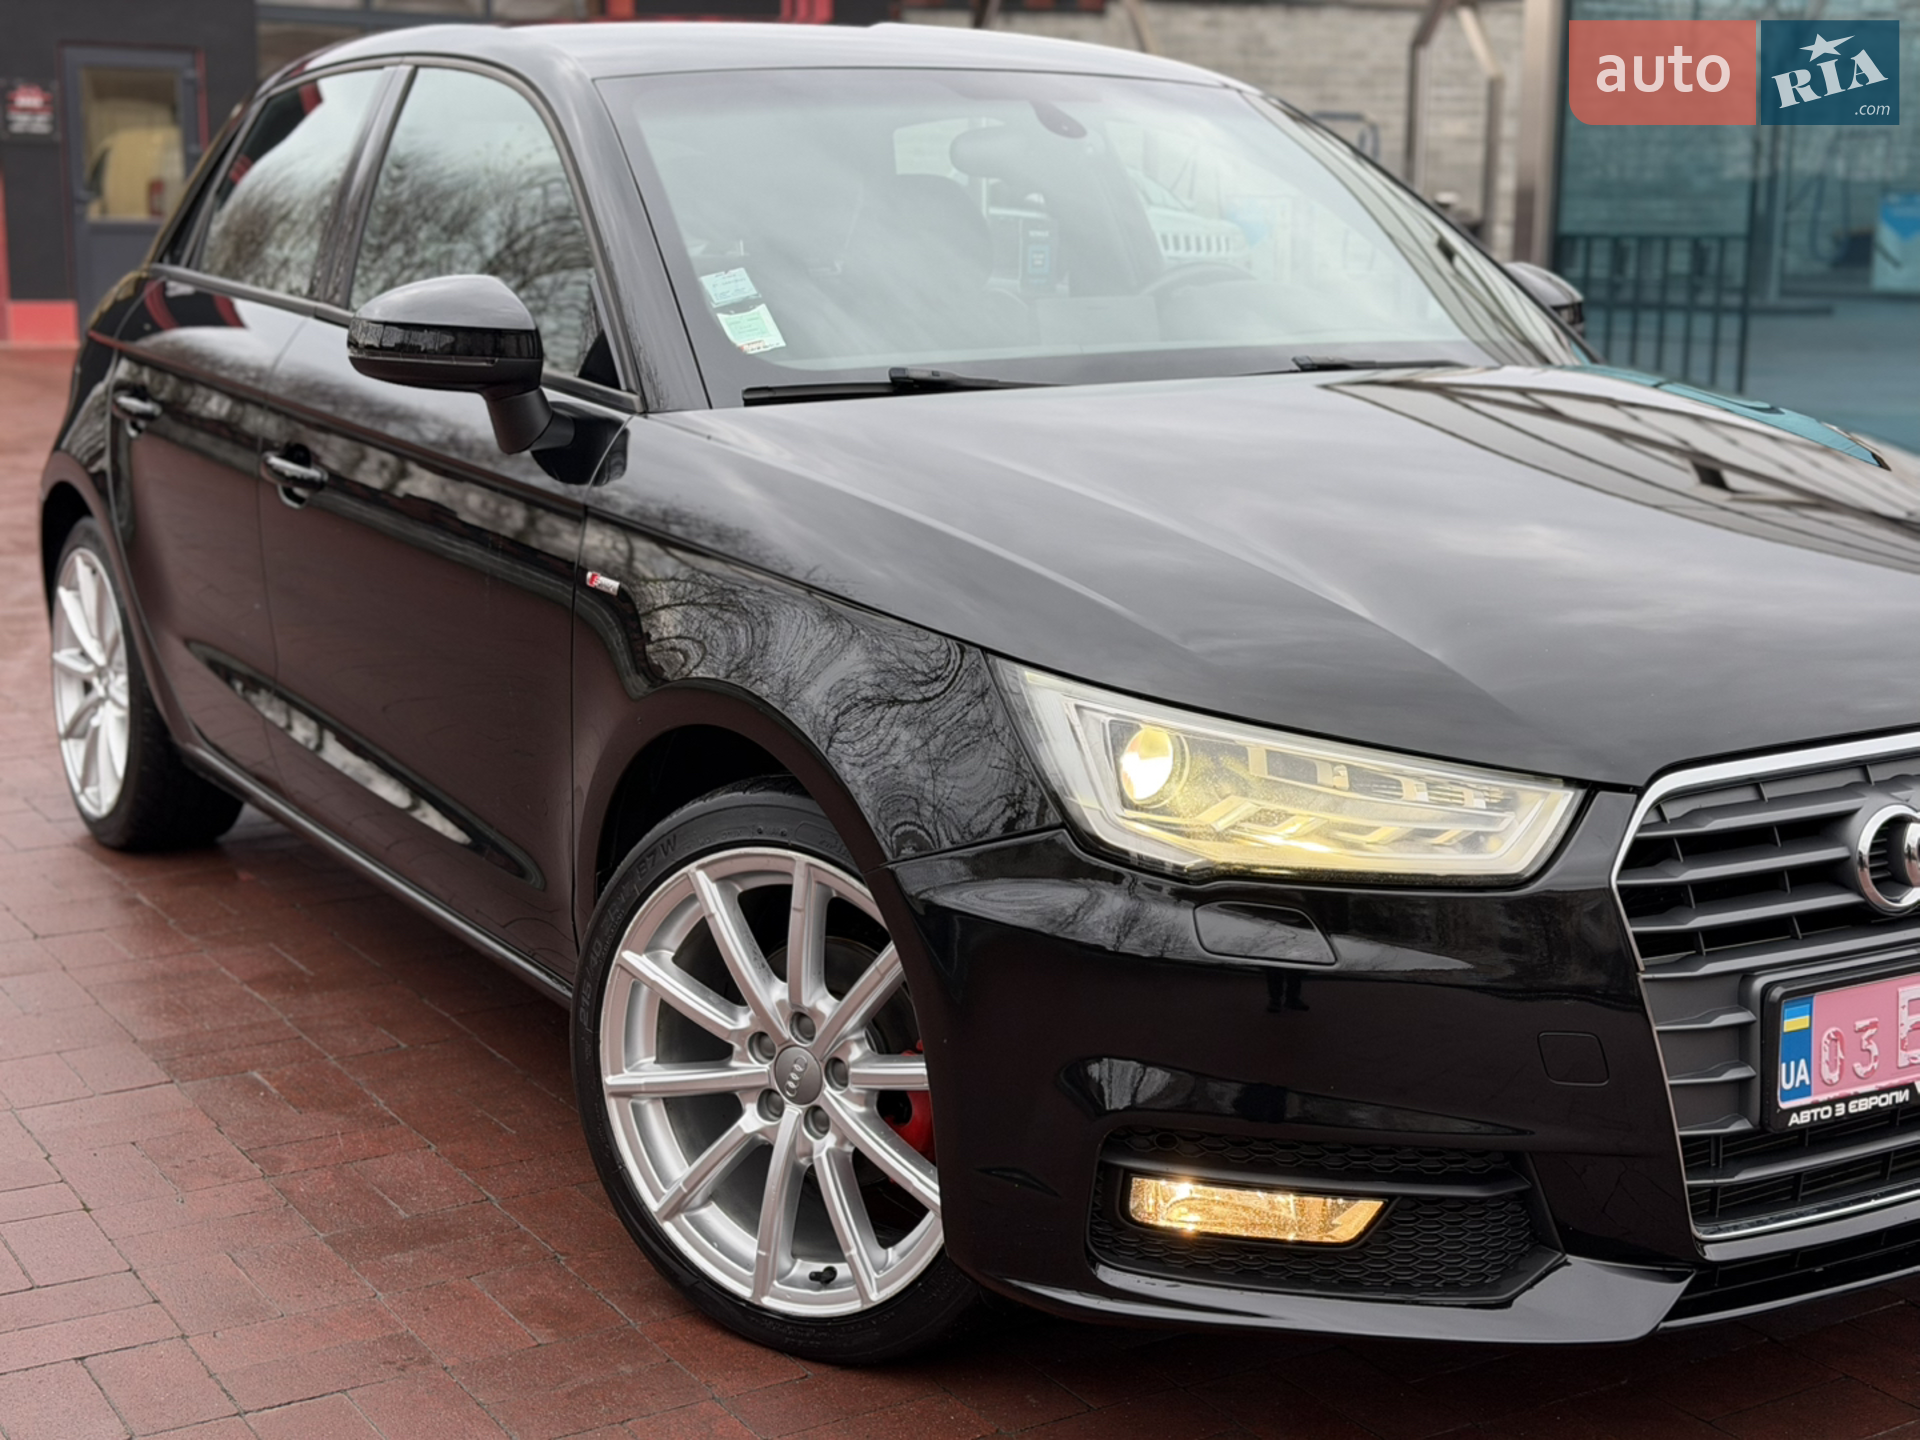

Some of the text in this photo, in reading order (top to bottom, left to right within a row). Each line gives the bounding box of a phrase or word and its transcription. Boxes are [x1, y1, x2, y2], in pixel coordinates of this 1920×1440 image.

[1781, 1058, 1810, 1090] UA
[1820, 1017, 1880, 1086] 03
[1788, 1104, 1833, 1127] АВТО
[1847, 1088, 1910, 1113] ЄВРОПИ
